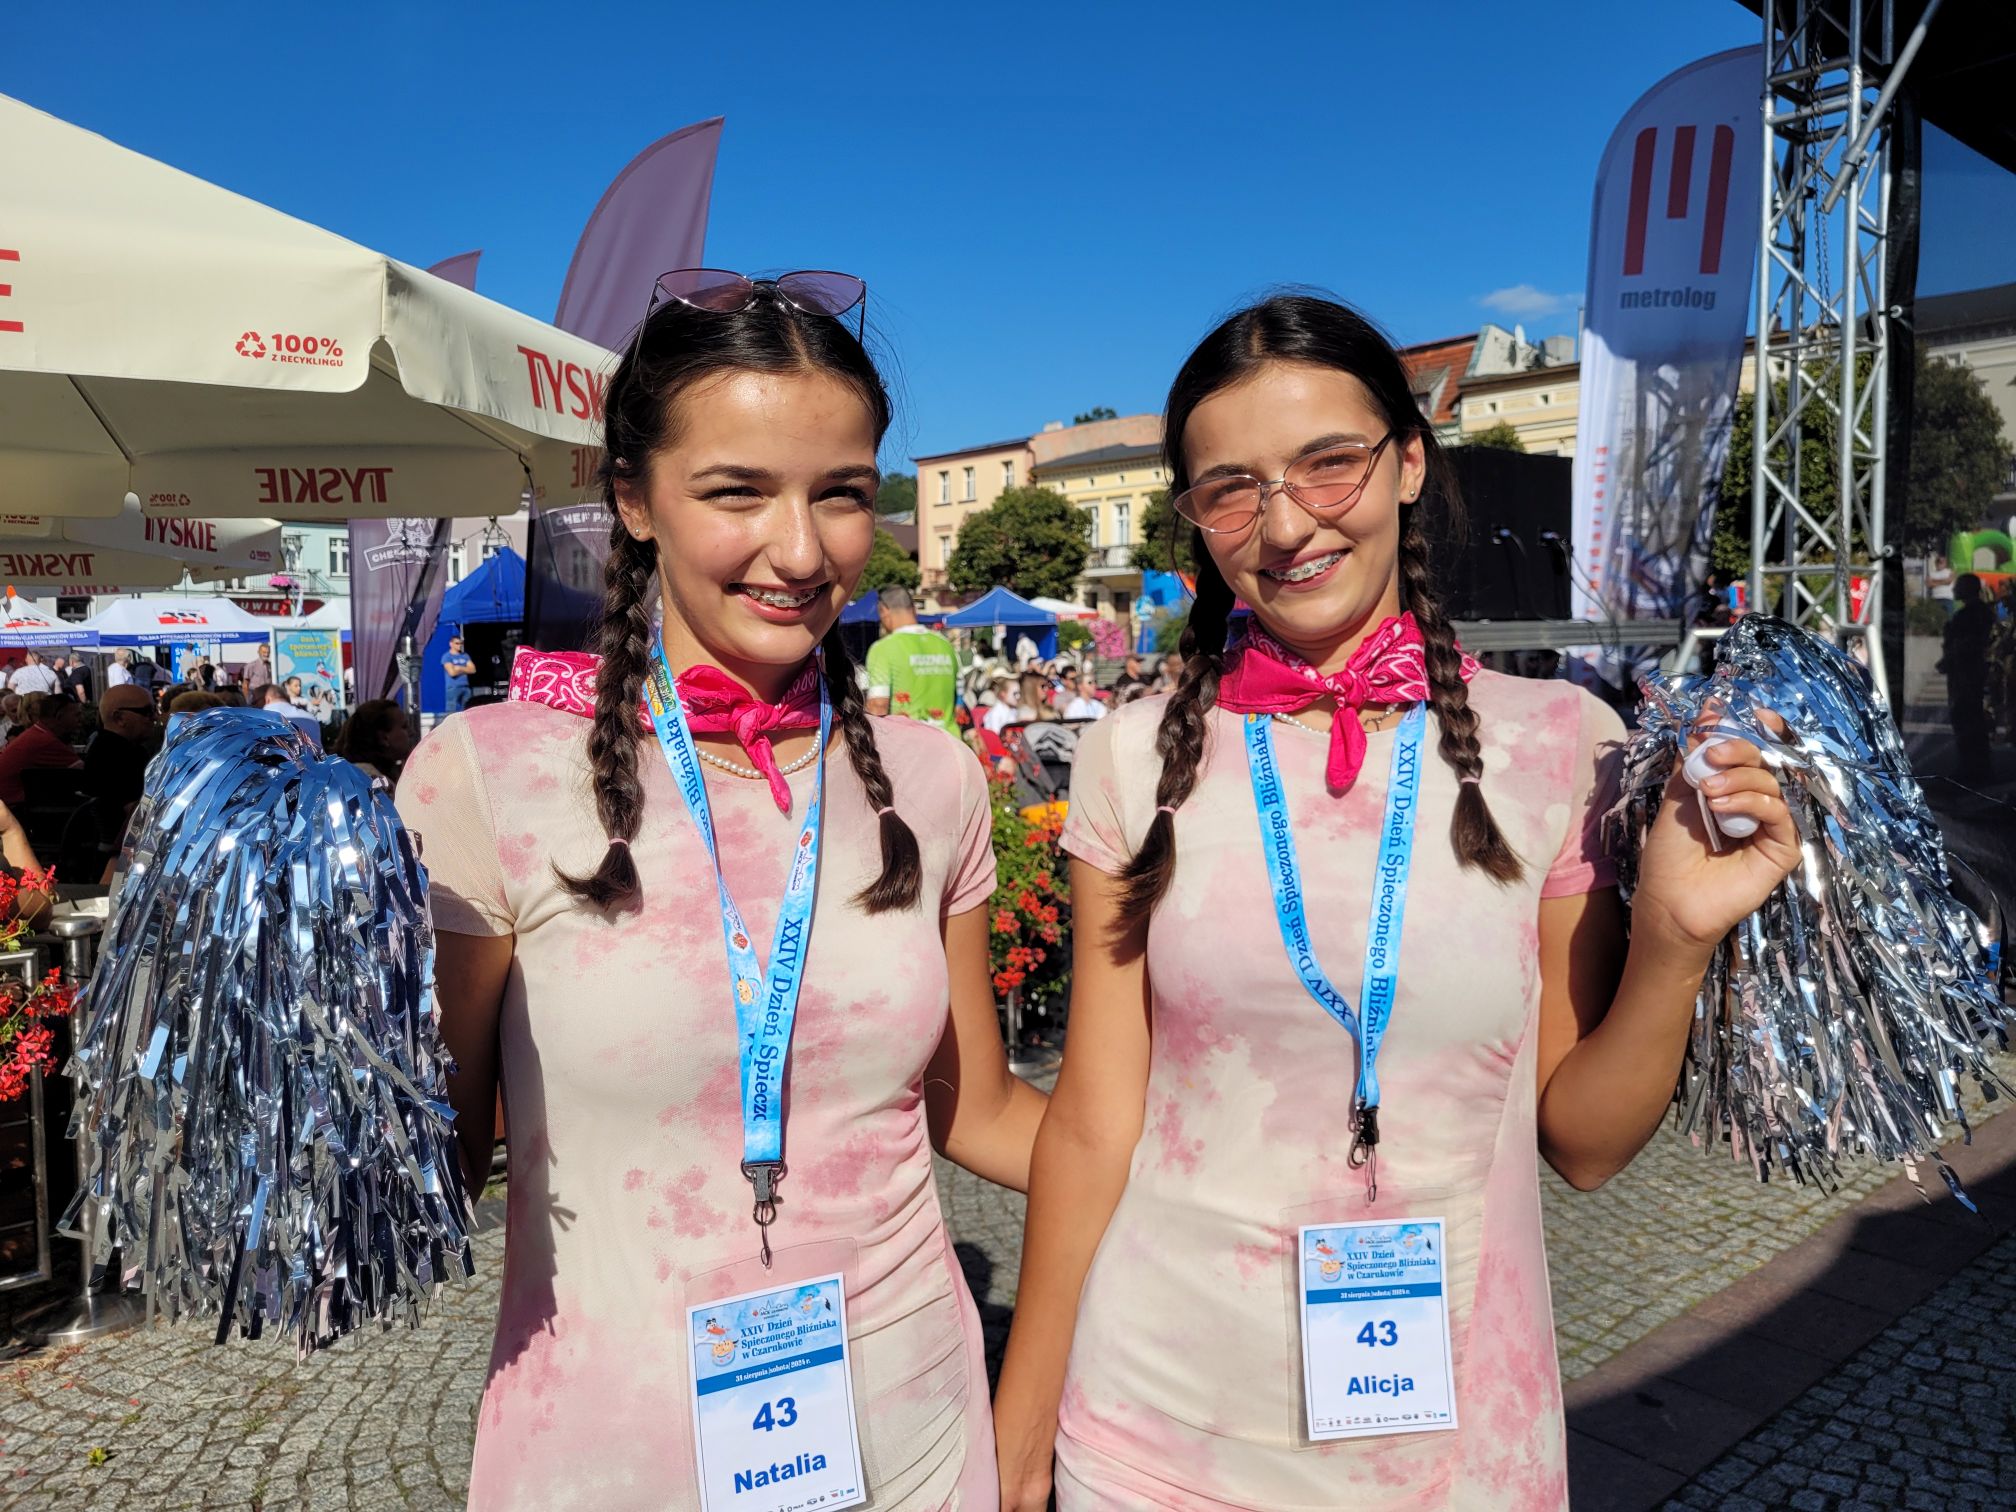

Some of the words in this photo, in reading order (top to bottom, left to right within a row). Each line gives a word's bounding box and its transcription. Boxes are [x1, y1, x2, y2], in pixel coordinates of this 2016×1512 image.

[1619, 287, 1716, 311] metrolog
[271, 333, 344, 357] 100%
[280, 354, 344, 367] RECYKLINGU
[517, 344, 609, 423] TYSK
[144, 517, 219, 552] TYSKIE
[667, 717, 702, 808] Bliźniaka
[1252, 725, 1280, 808] Bliźniaka
[1395, 741, 1418, 791] XXIV
[1388, 795, 1412, 849] Dzień
[1269, 810, 1300, 914] Spieczonego
[1369, 853, 1405, 969] Spieczonego
[777, 917, 803, 972] XXIV
[1289, 917, 1314, 974] Dzień
[762, 976, 793, 1038] Dzień
[1306, 978, 1353, 1023] XXIV
[1346, 1251, 1369, 1261] XXIV
[1371, 1249, 1395, 1260] Dzień
[1346, 1260, 1397, 1272] Spieczonego
[1399, 1257, 1436, 1267] Bliźniaka
[1356, 1269, 1404, 1280] Czarnkowie
[740, 1323, 765, 1338] XXIV
[767, 1317, 793, 1331] Dzień
[741, 1330, 796, 1349] Spieczonego
[796, 1319, 837, 1336] Bliźniaka
[1356, 1320, 1399, 1348] 43
[742, 1352, 750, 1360] w
[751, 1338, 803, 1357] Czarnkowie
[743, 1368, 770, 1381] sierpnia
[1346, 1374, 1415, 1397] Alicja
[752, 1396, 798, 1432] 43
[733, 1453, 827, 1494] Natalia
